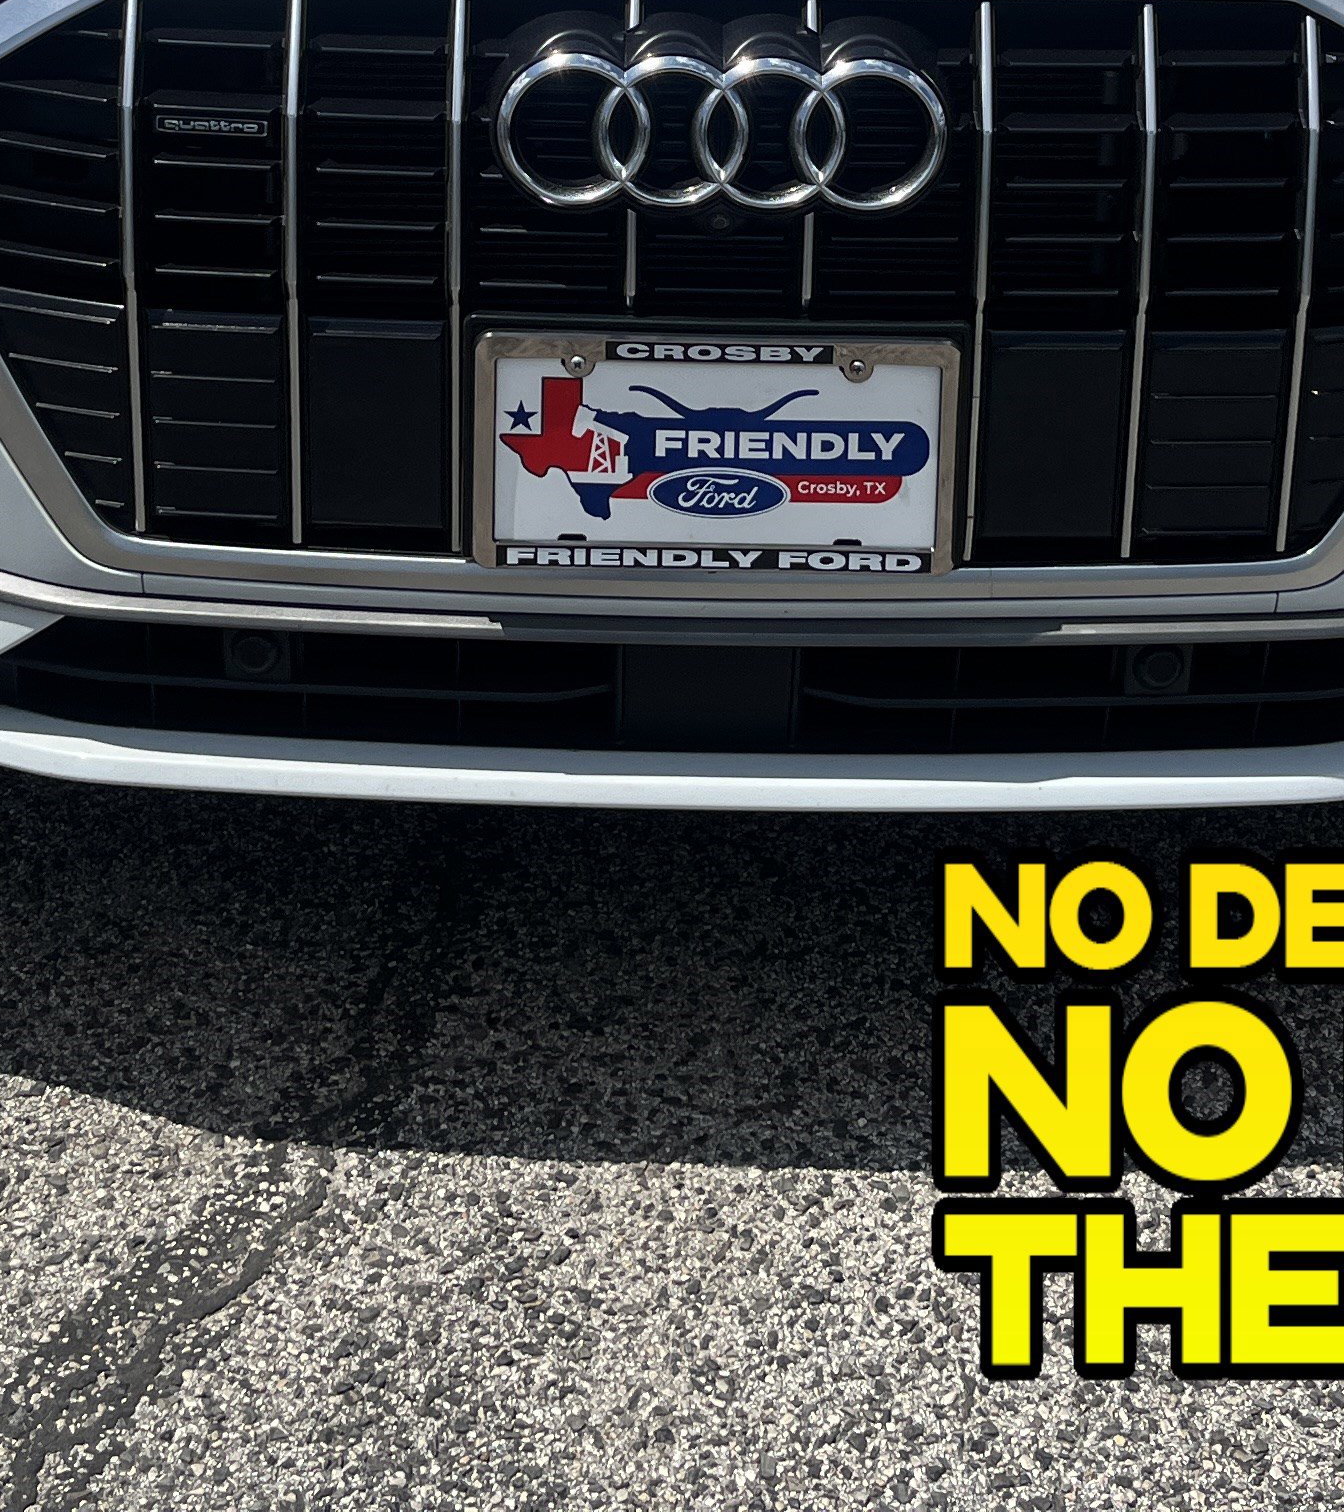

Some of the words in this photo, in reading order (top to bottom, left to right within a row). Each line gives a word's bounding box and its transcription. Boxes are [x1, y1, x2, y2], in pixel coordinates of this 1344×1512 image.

[163, 118, 259, 133] quattro
[616, 343, 825, 363] CROSBY
[654, 429, 906, 461] FRIENDLY
[677, 476, 759, 509] Ford
[797, 481, 861, 498] Crosby,
[863, 482, 887, 495] TX
[506, 547, 763, 569] FRIENDLY
[778, 551, 923, 572] FORD
